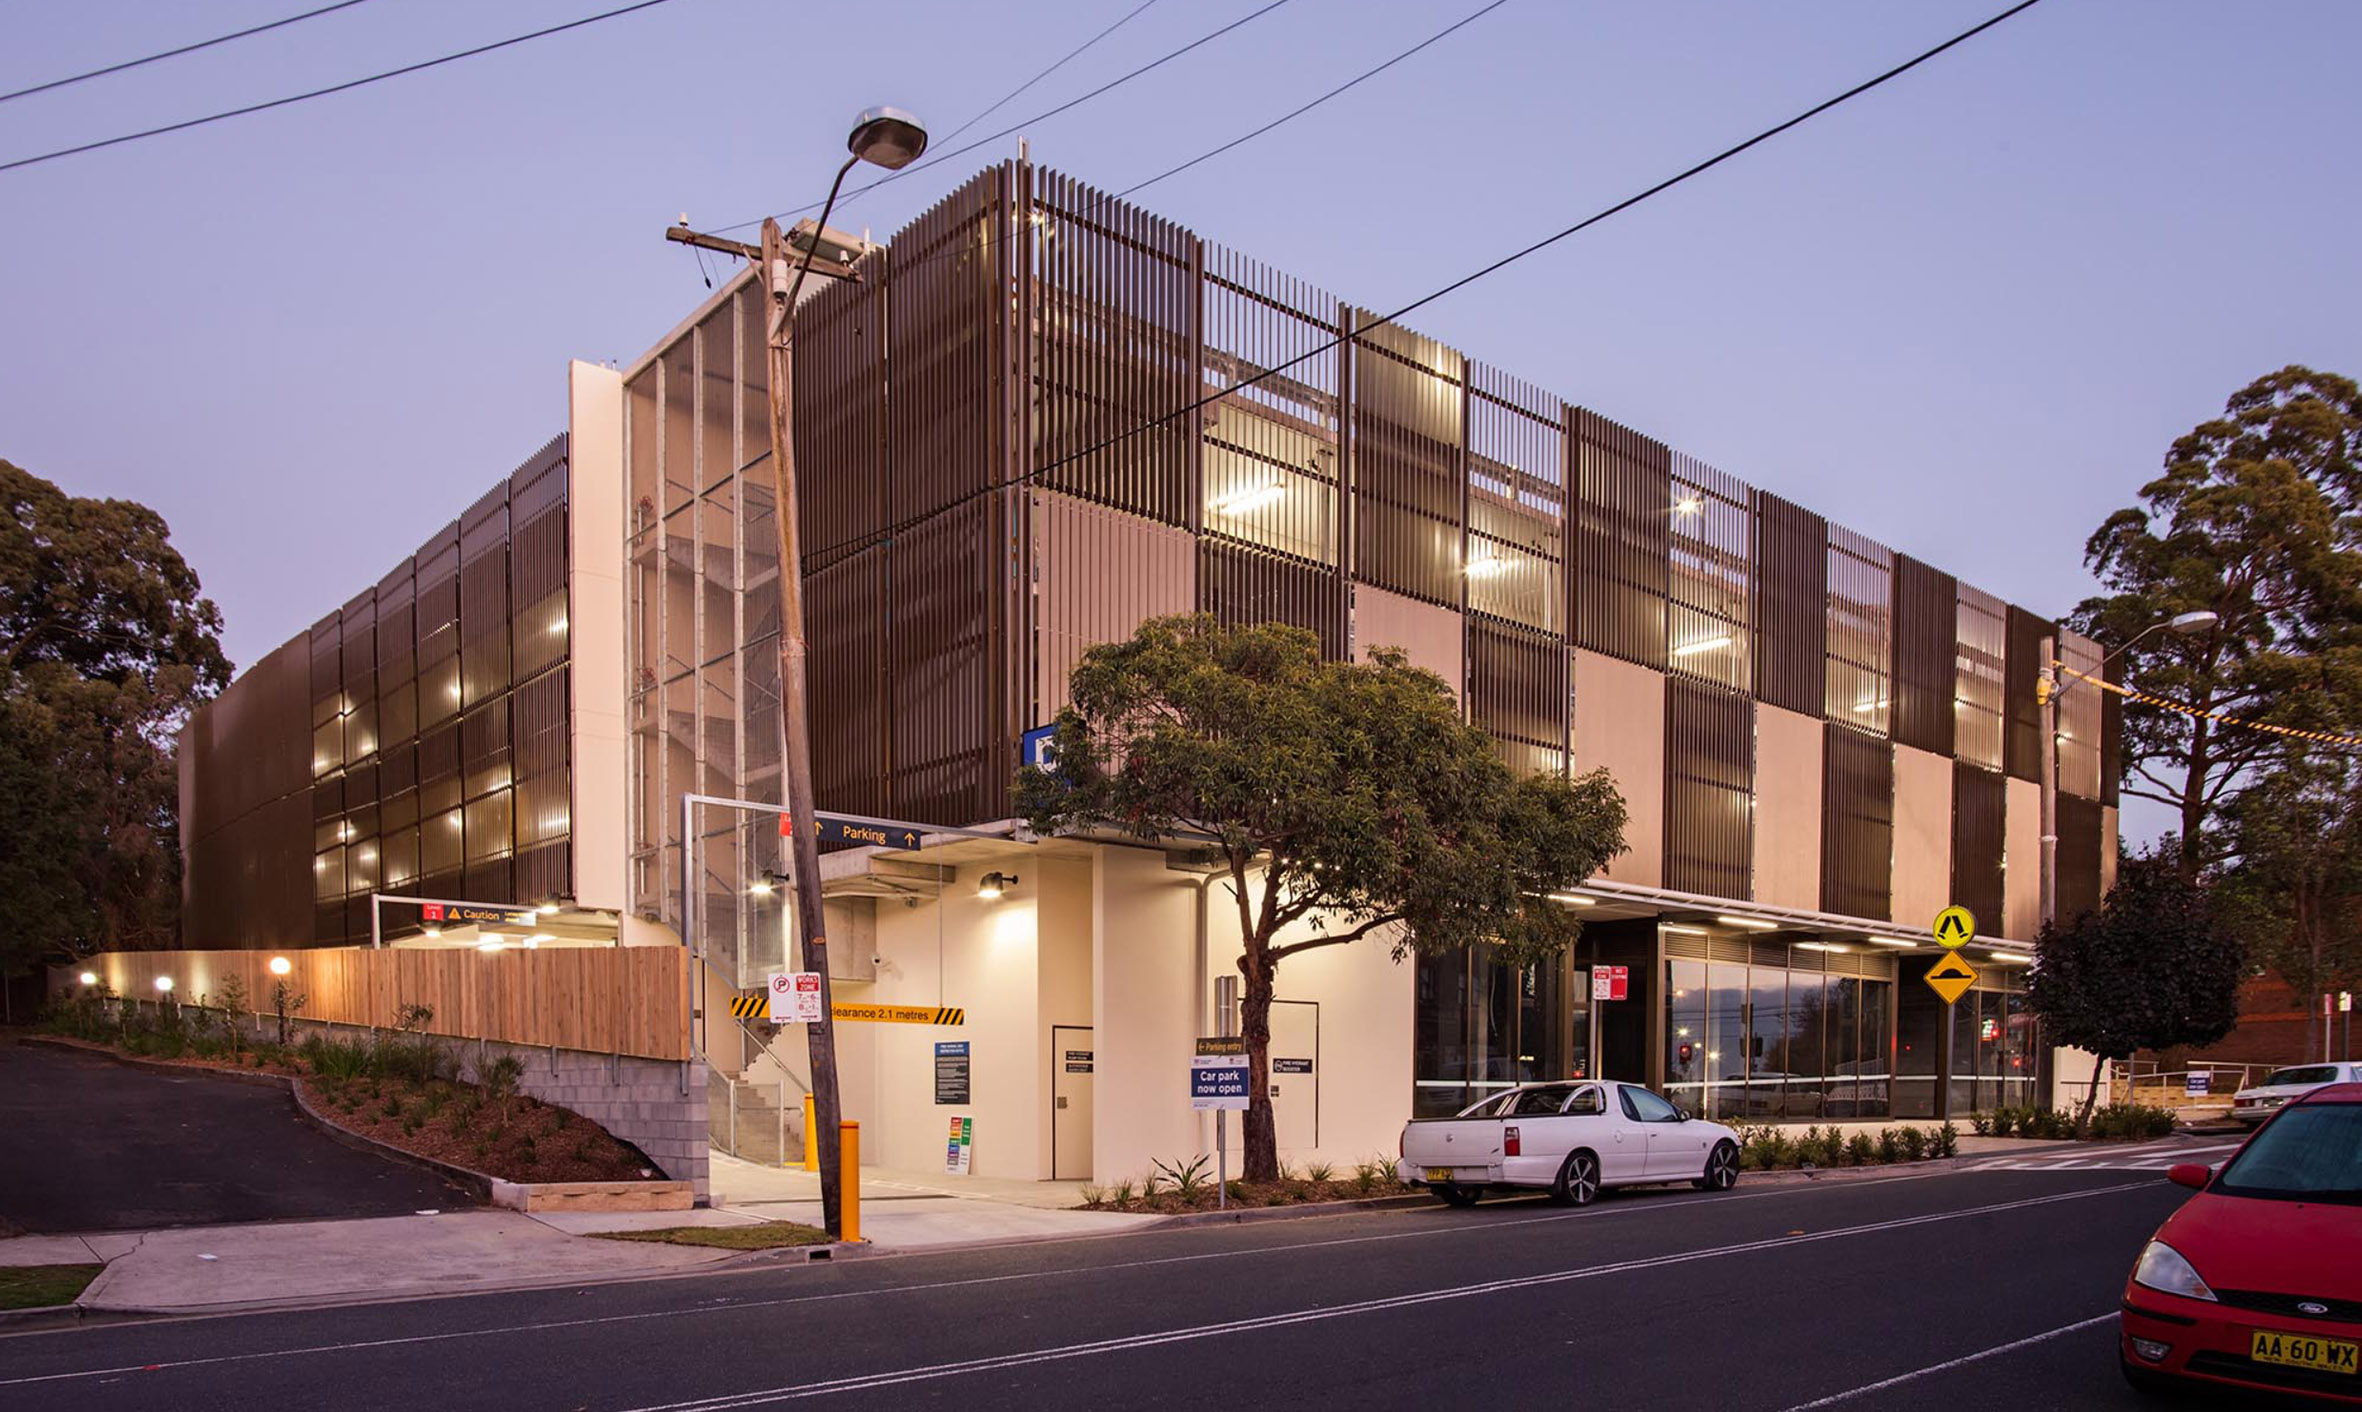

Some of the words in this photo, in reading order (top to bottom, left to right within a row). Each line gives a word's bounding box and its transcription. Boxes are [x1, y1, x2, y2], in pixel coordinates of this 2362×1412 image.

[842, 825, 886, 844] Parking
[463, 909, 500, 920] Caution
[832, 1006, 876, 1018] learance
[878, 1009, 892, 1019] 2.1
[896, 1011, 928, 1020] metres
[1206, 1043, 1226, 1052] Parking
[1227, 1043, 1242, 1052] entry
[1200, 1071, 1216, 1082] Car
[1218, 1070, 1239, 1083] park
[1197, 1085, 1216, 1093] now
[1218, 1085, 1242, 1095] open
